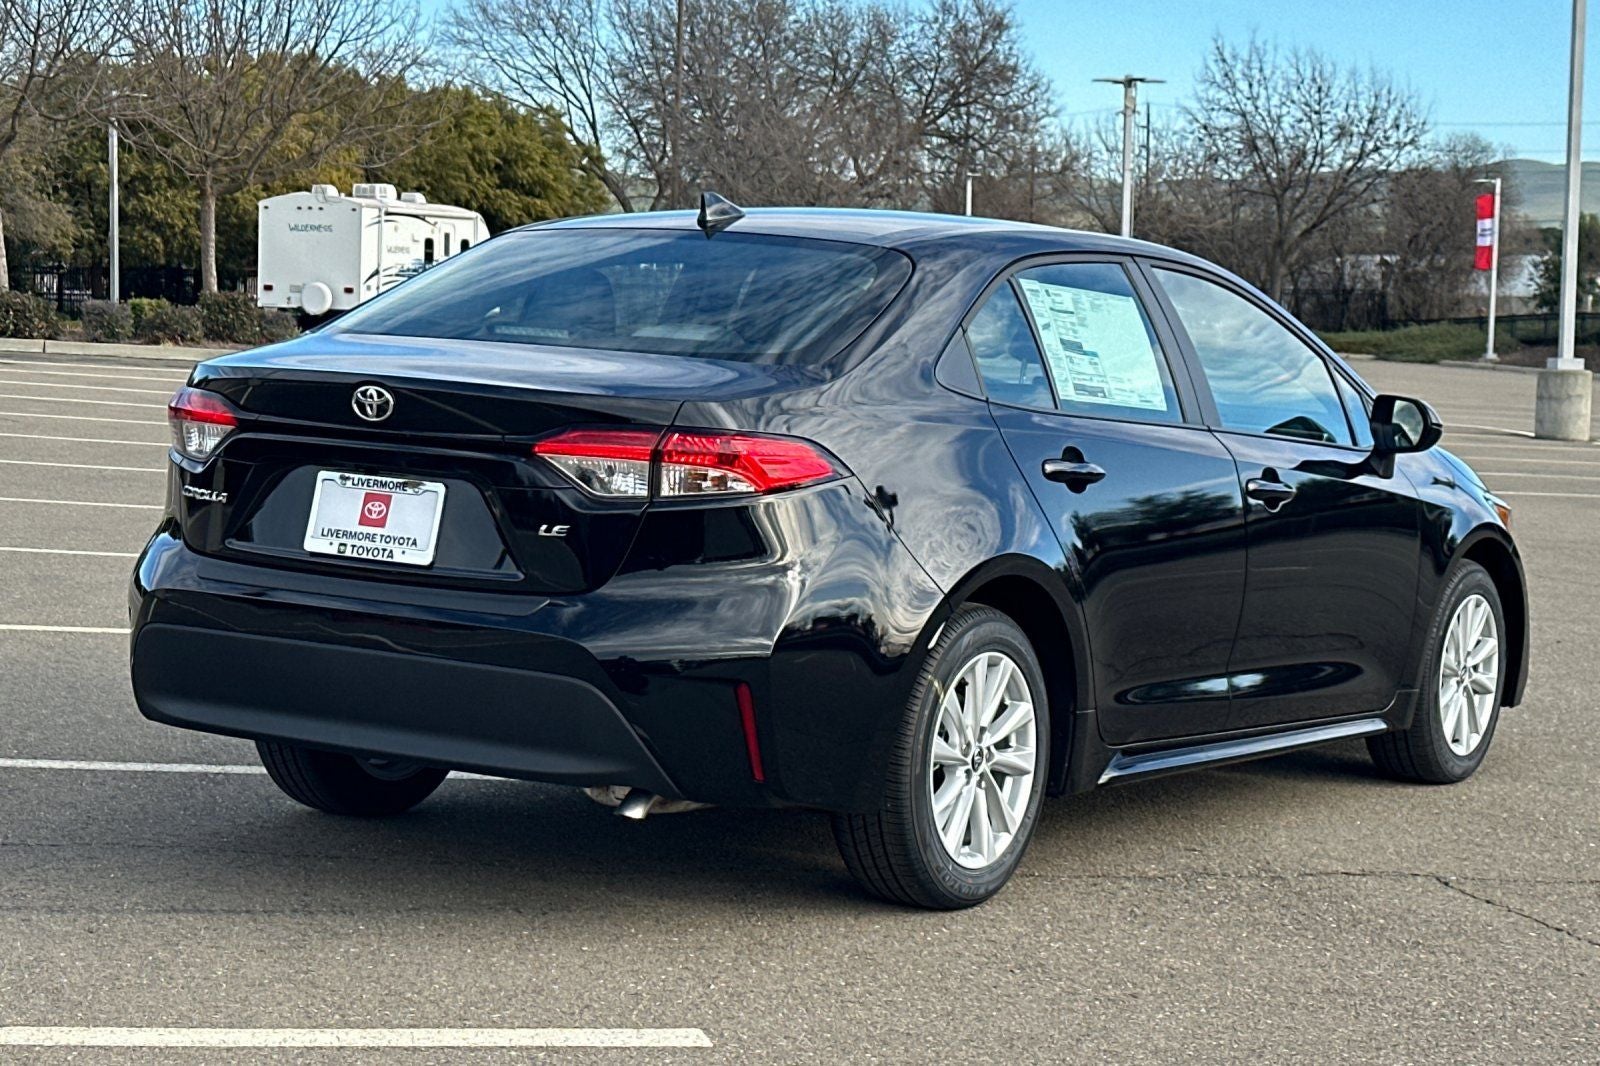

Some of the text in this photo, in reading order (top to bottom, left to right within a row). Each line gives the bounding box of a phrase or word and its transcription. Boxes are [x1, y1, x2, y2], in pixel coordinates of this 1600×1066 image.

[288, 223, 333, 233] WILDERNESS
[351, 477, 408, 492] LIVERMORE
[321, 527, 418, 548] LIVERMORE TOYOTA
[538, 524, 571, 537] LE
[350, 544, 394, 559] TOYOTA
